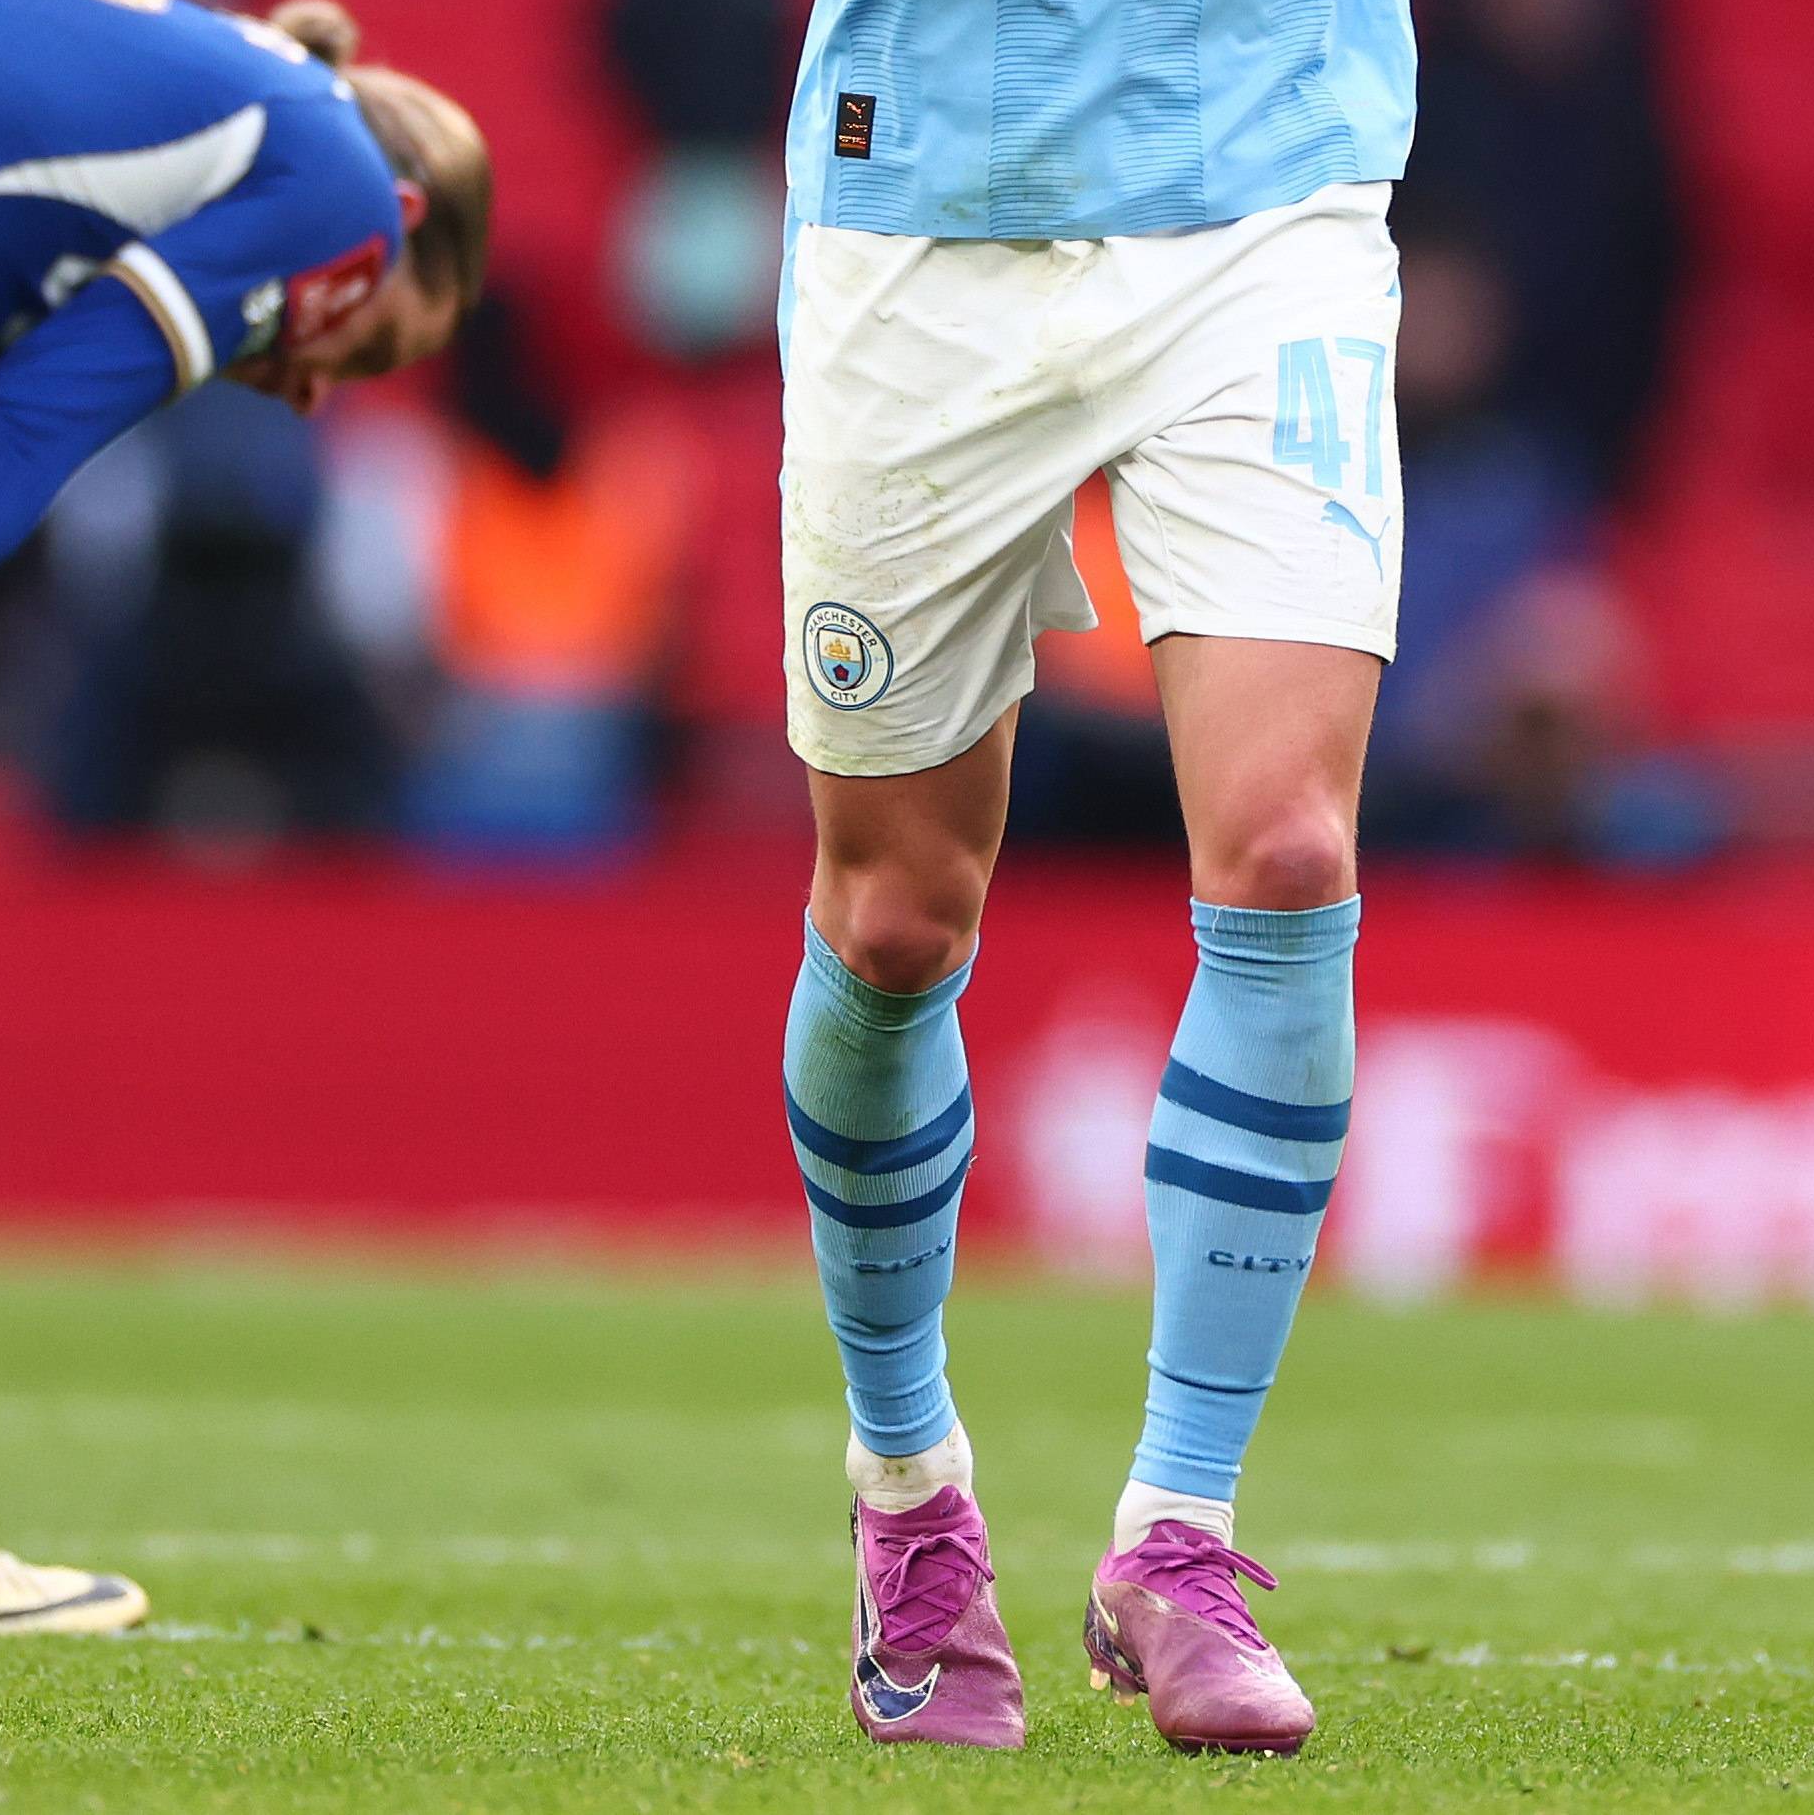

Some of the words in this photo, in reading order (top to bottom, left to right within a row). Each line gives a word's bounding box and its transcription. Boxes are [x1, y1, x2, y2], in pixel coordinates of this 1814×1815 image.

[1273, 336, 1386, 498] 47
[808, 611, 878, 647] MANCHESTER
[830, 691, 858, 703] CITY
[1207, 1249, 1312, 1273] CITY
